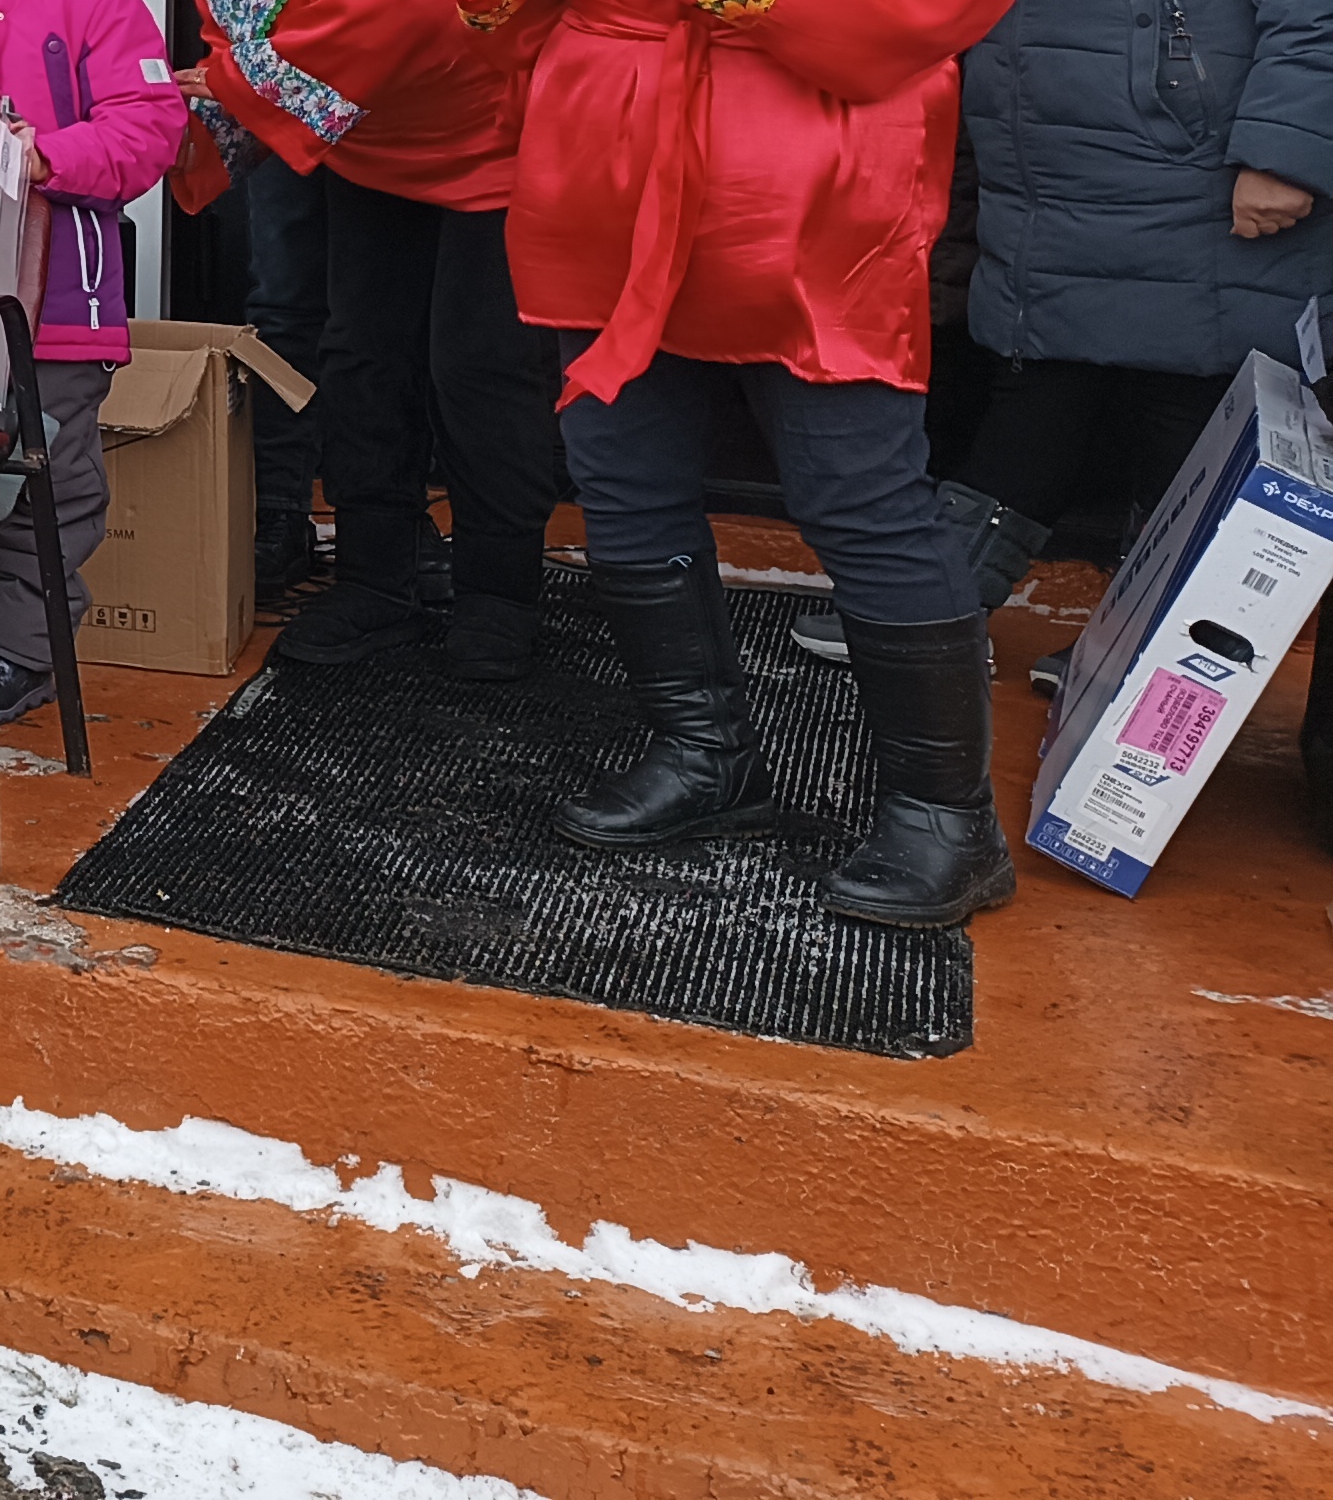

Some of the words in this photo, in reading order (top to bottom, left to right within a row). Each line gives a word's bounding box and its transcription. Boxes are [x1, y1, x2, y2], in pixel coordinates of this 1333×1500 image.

[1283, 491, 1333, 519] DEXP
[1169, 705, 1216, 772] 394197713
[1121, 750, 1160, 769] 5042232
[1102, 773, 1132, 791] DEXP
[1070, 829, 1107, 852] 5042232
